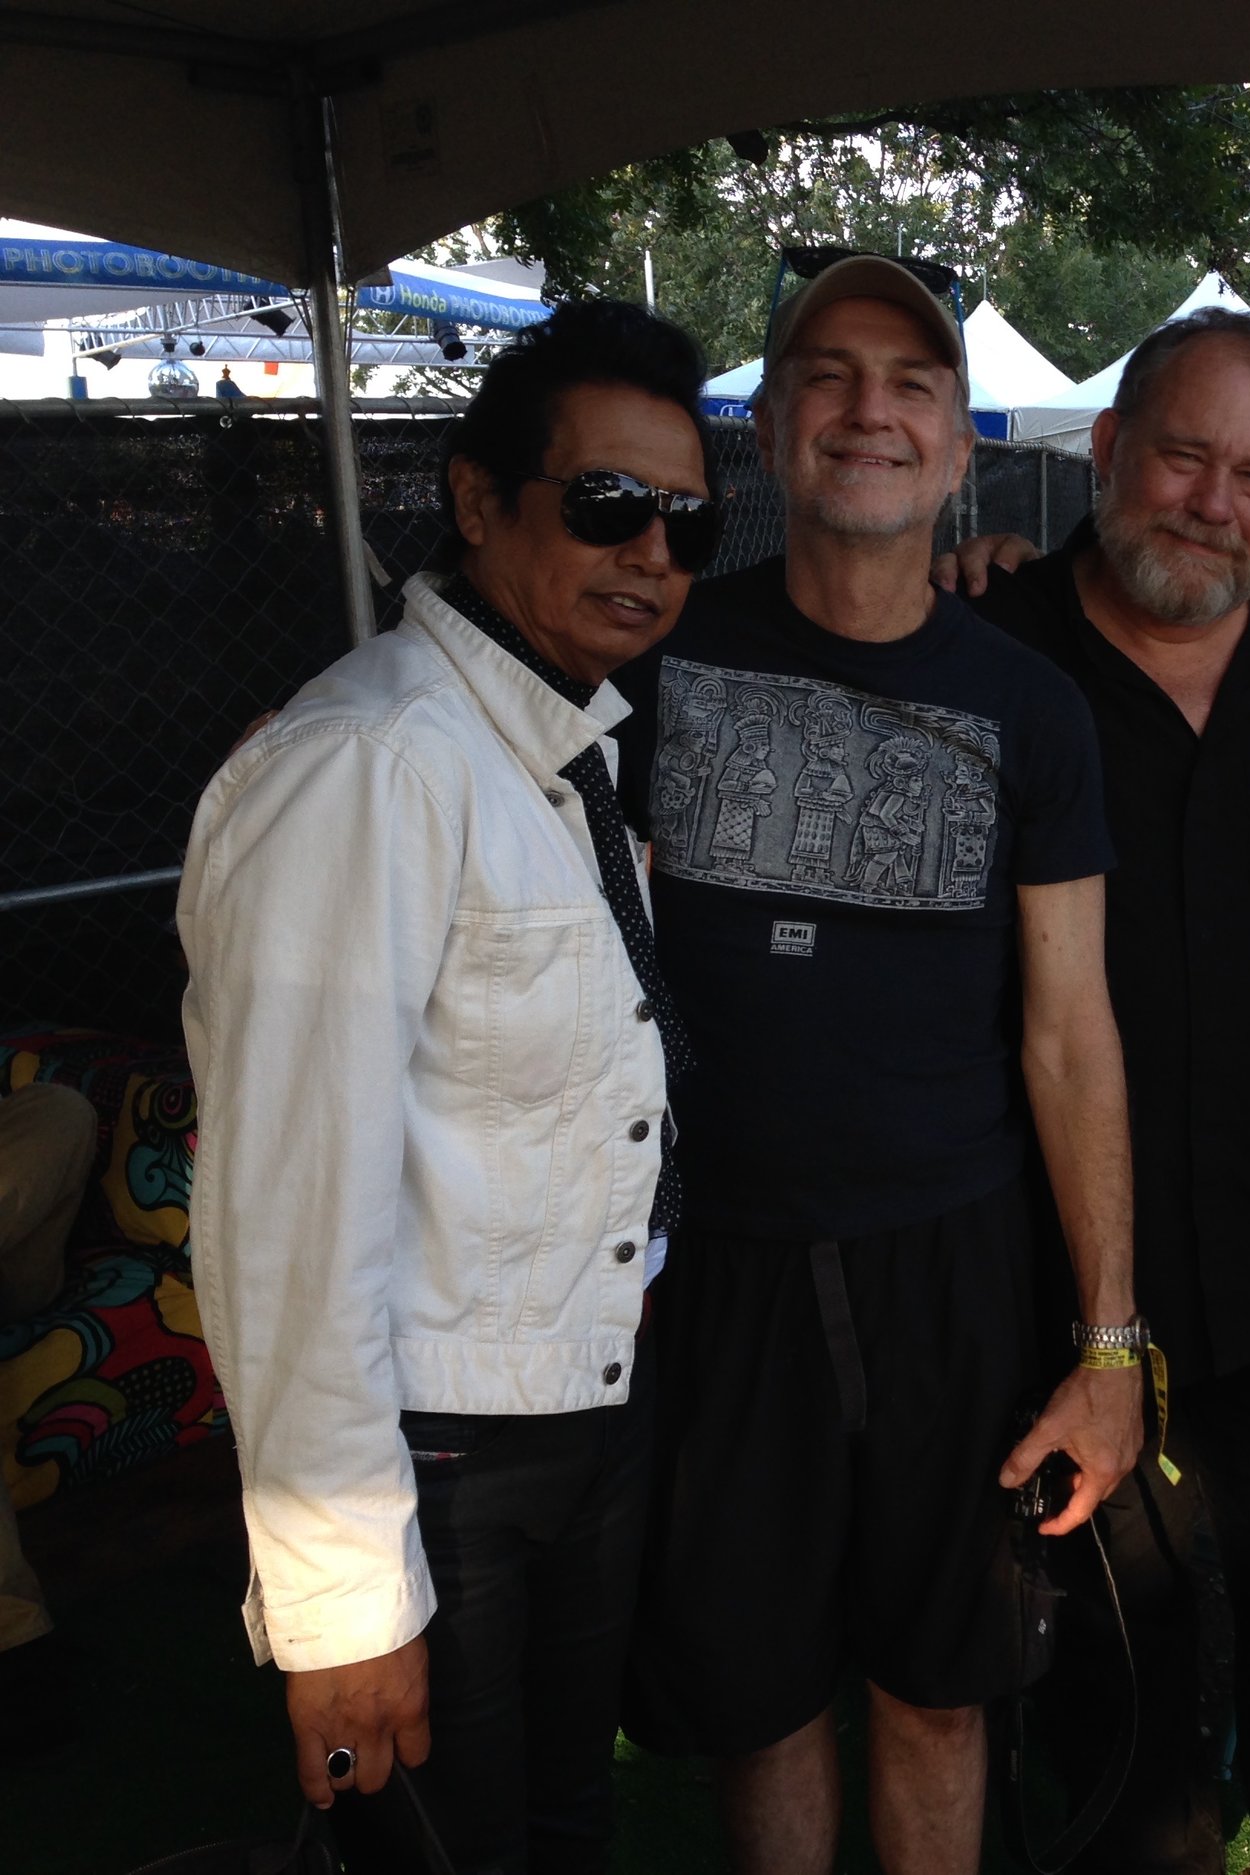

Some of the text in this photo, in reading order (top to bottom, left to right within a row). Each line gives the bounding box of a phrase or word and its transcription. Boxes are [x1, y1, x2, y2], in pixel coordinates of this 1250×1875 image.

[400, 284, 447, 313] Honda
[779, 927, 808, 939] EMI
[770, 944, 813, 954] AMERICA
